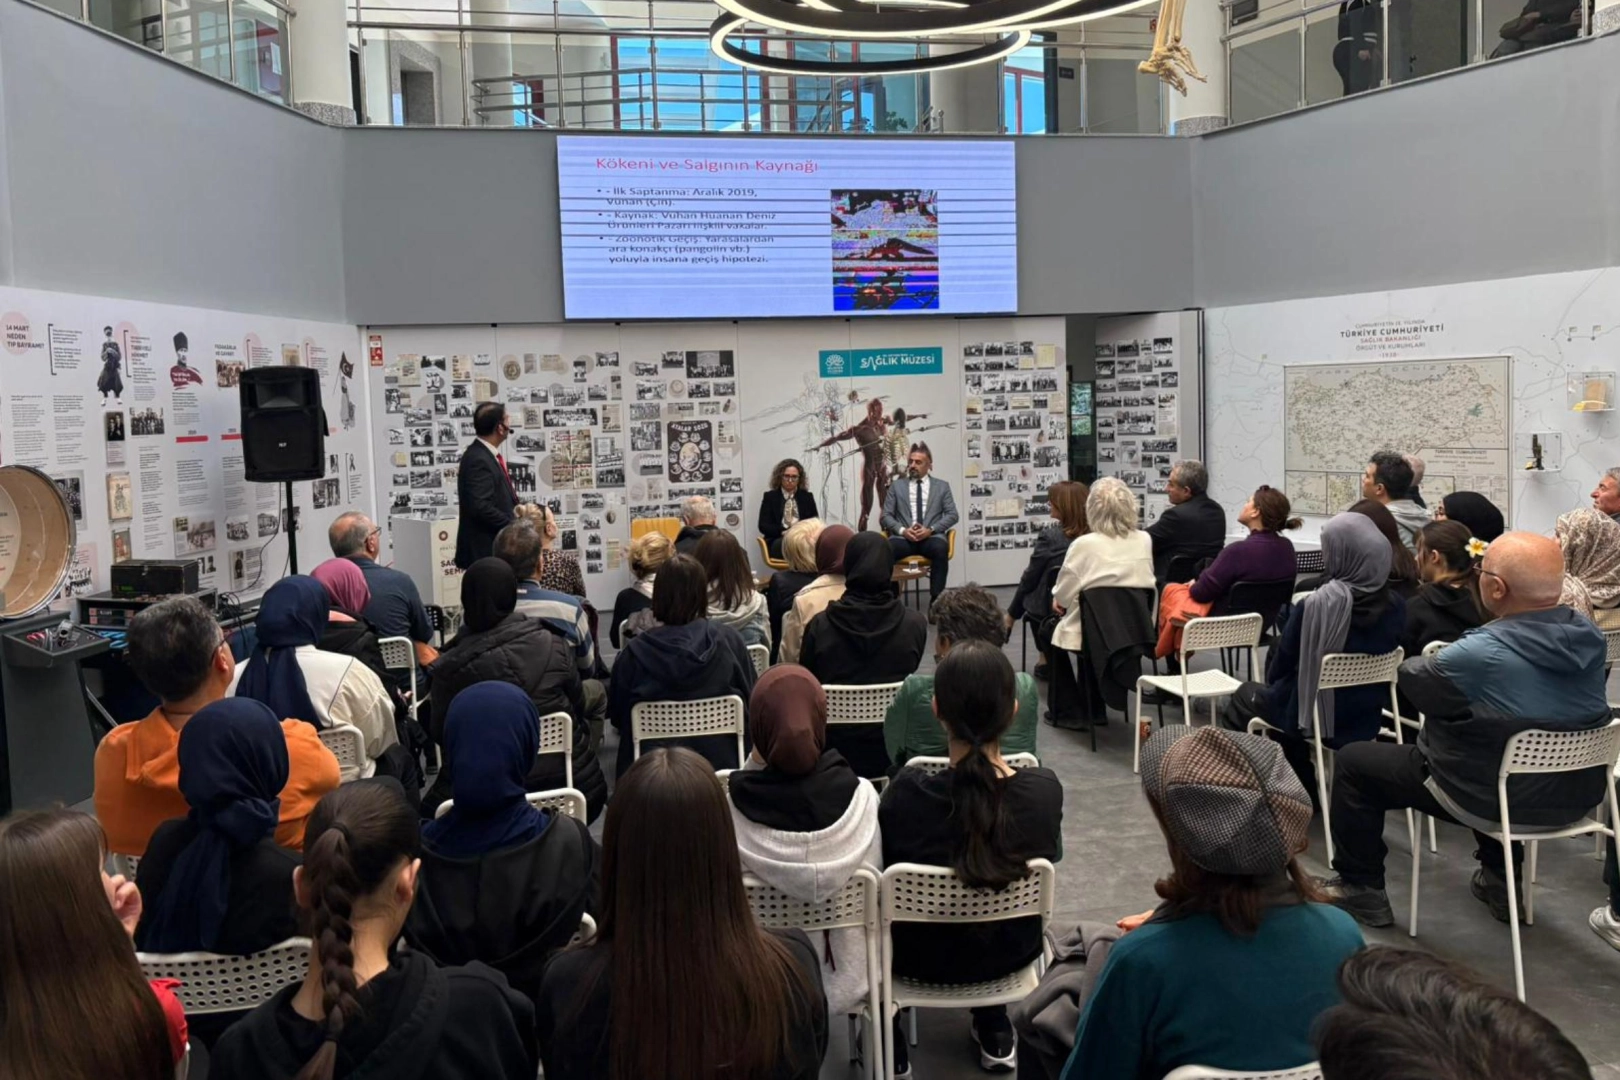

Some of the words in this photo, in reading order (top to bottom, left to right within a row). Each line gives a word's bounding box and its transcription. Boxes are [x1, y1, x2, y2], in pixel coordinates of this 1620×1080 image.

[596, 158, 654, 170] Kökeni
[659, 161, 679, 170] ve
[684, 159, 749, 173] Salgının
[756, 160, 818, 174] Kaynağı
[629, 187, 690, 197] Saptanma:
[692, 188, 724, 197] Aralık
[727, 188, 758, 198] 2019,
[614, 211, 658, 220] Kaynak:
[700, 212, 743, 220] Huanan
[746, 212, 776, 220] Deniz
[630, 245, 673, 254] konakçı
[608, 255, 650, 264] yoluyla
[691, 256, 719, 264] geçiş
[721, 255, 769, 264] hipotezi.
[1340, 329, 1377, 338] TÜRKİYE
[1380, 323, 1444, 336] CUMHURİYETİ
